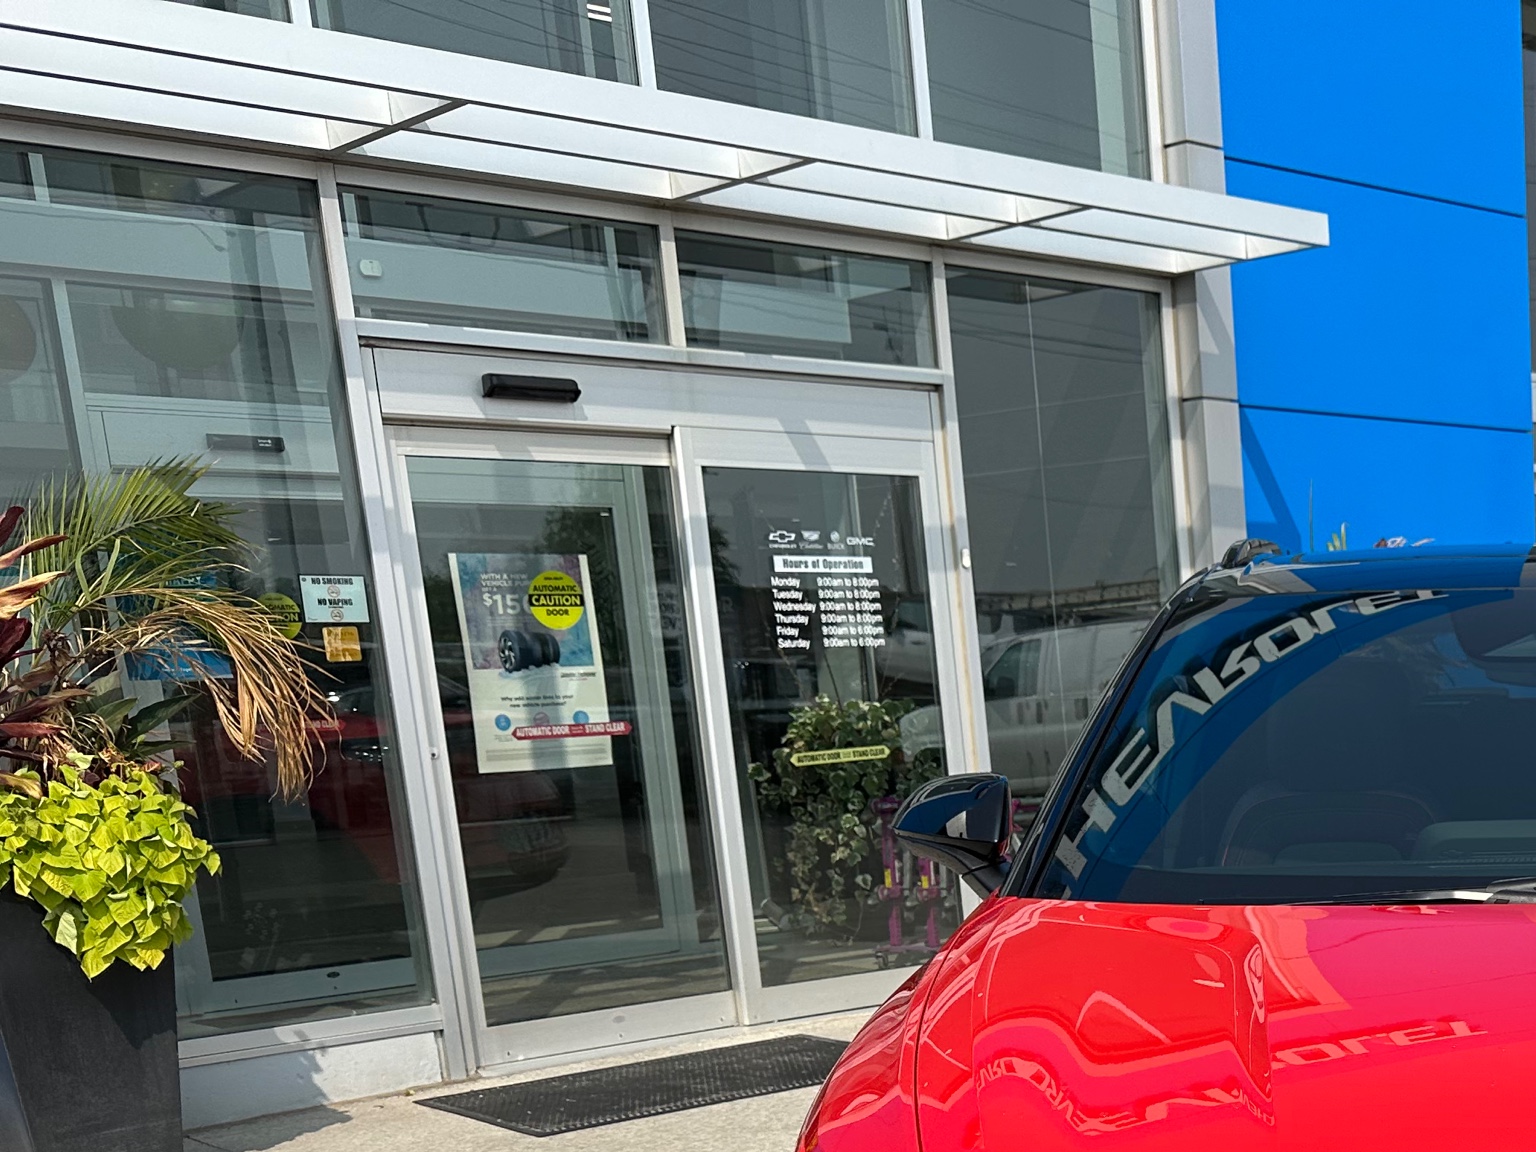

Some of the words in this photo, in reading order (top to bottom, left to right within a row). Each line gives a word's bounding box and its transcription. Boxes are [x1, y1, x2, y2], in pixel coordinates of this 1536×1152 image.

[846, 537, 875, 546] GMC
[782, 558, 809, 569] Hours
[811, 558, 820, 569] of
[822, 559, 864, 571] Operation
[311, 577, 321, 585] NO
[322, 577, 354, 586] SMOKING
[770, 576, 800, 589] Monday
[844, 577, 852, 587] to
[533, 584, 578, 593] AUTOMATIC
[772, 588, 803, 601] Tuesday
[845, 589, 853, 599] to
[317, 598, 327, 606] NO
[328, 598, 354, 606] VAPING
[531, 595, 581, 605] CAUTION
[546, 608, 570, 617] DOOR
[773, 601, 816, 613] Wednesday
[847, 601, 854, 611] to
[774, 613, 809, 626] Thursday
[848, 613, 855, 623] to
[776, 625, 799, 637] Friday
[849, 625, 857, 635] to
[778, 637, 811, 650] Saturday
[850, 637, 858, 647] to
[516, 725, 551, 737] AUTOMATIC
[552, 725, 571, 736] DOOR
[585, 723, 606, 733] STAND
[606, 722, 625, 732] CLEAR
[797, 752, 826, 763] AUTOMATIC
[827, 751, 841, 761] DOOR
[852, 749, 869, 759] STAND
[869, 747, 885, 756] CLEAR
